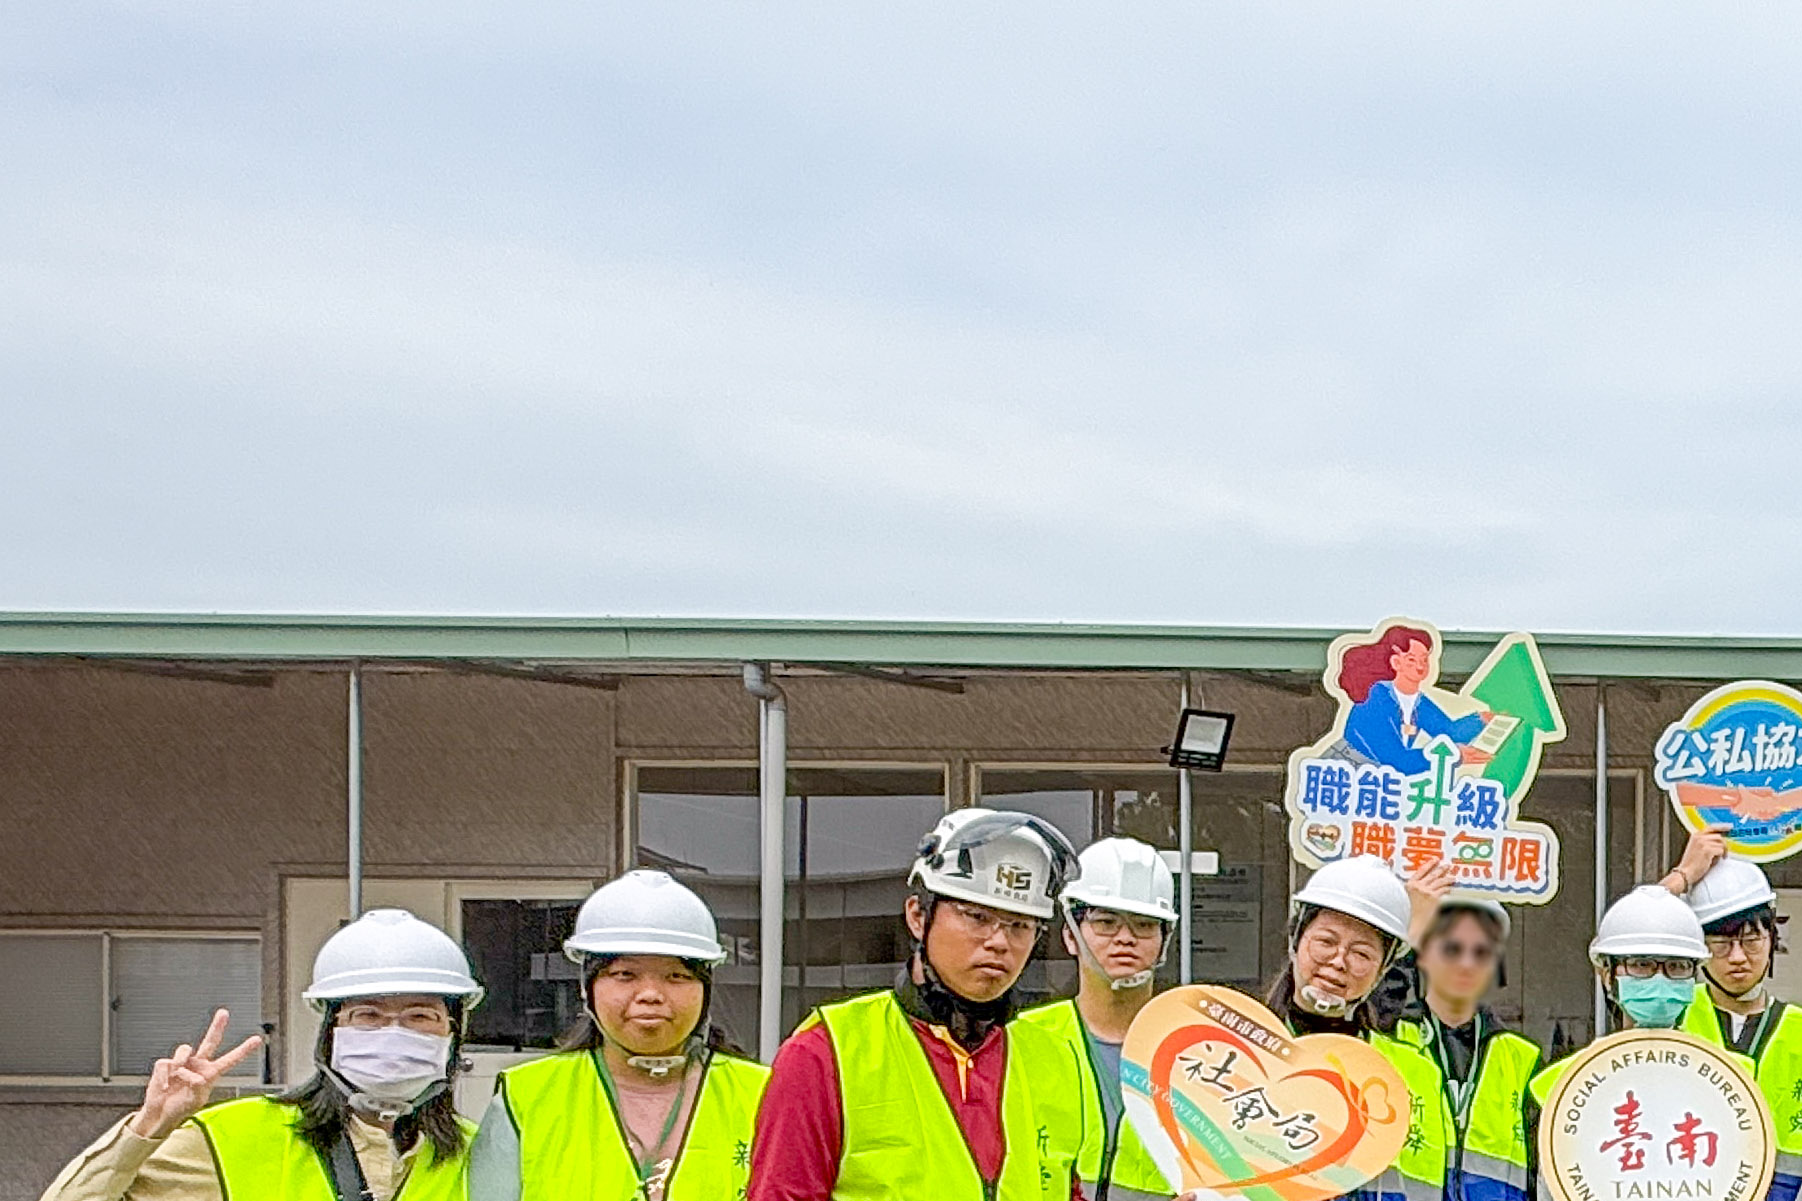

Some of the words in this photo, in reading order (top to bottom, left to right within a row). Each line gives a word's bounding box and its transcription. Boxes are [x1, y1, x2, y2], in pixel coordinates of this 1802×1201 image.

[1303, 745, 1499, 831] 職能升級
[1350, 821, 1541, 882] 職夢無限
[1161, 1091, 1234, 1161] GOVERNMENT
[1178, 1043, 1319, 1150] 社會局
[1564, 1072, 1606, 1135] SOCIAL
[1610, 1050, 1691, 1073] AFFAIRS
[1697, 1062, 1753, 1131] BUREAU
[1600, 1090, 1719, 1172] 臺南
[1610, 1179, 1713, 1199] TAINAN
